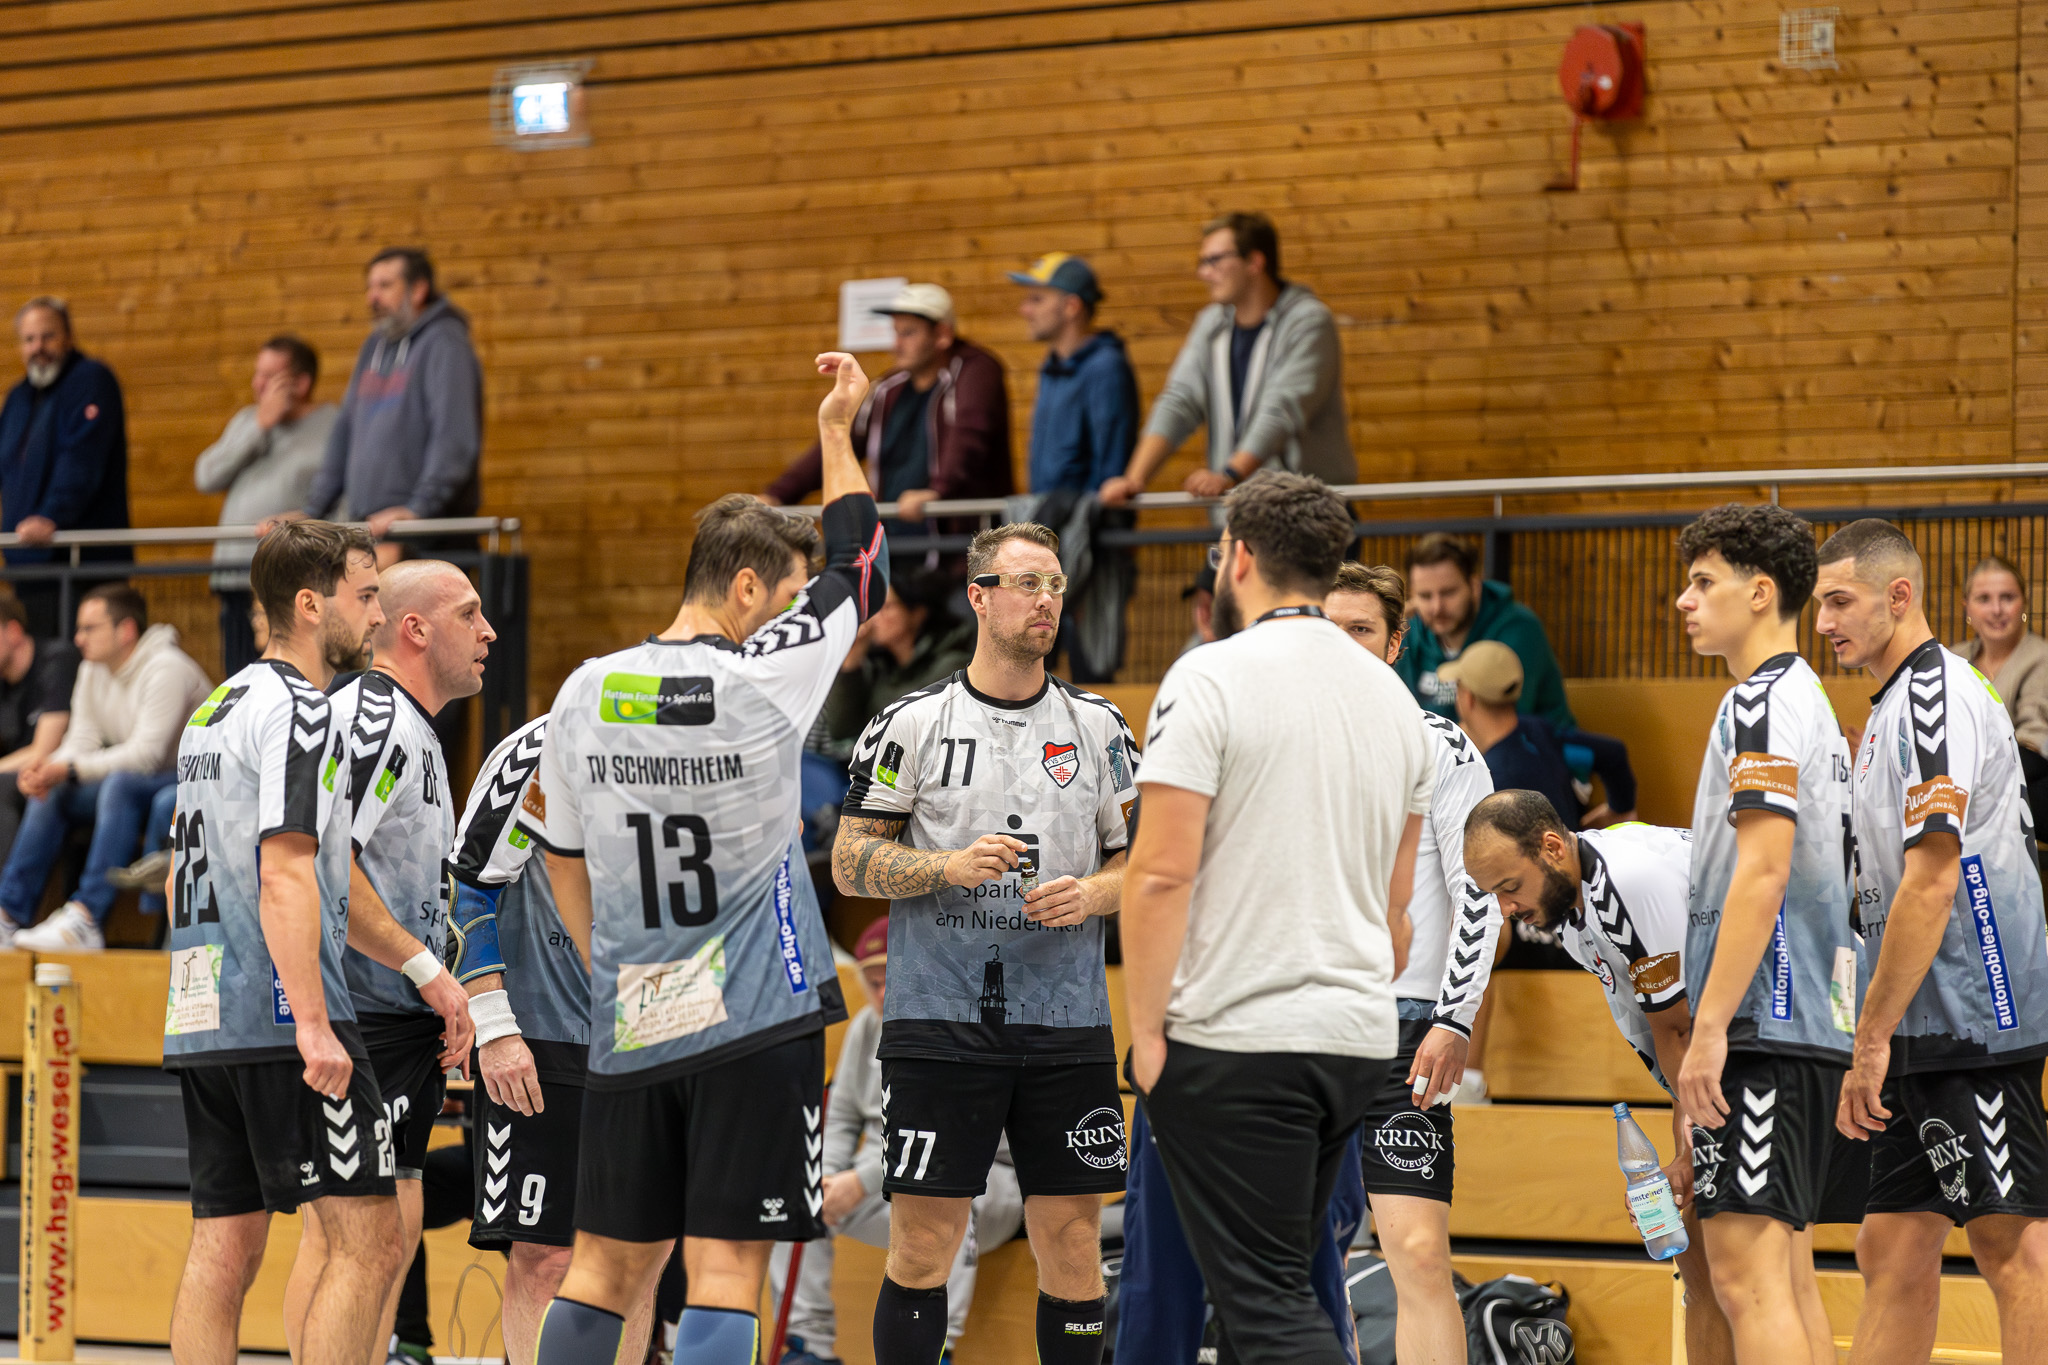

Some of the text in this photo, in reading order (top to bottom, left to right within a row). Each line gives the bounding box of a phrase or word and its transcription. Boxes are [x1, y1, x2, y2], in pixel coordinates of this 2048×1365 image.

[673, 693, 696, 705] Sport
[698, 692, 712, 703] AG
[1059, 752, 1074, 762] 1900
[586, 753, 744, 786] TV SCHWAFHEIM
[626, 813, 719, 929] 13
[936, 911, 964, 929] am
[1965, 863, 2013, 1027] automobiles-ohg.de
[1374, 1129, 1445, 1151] KRINK
[894, 1129, 936, 1180] 77
[1084, 1145, 1125, 1167] LIQUEURS
[1386, 1151, 1432, 1168] LIQUEURS
[45, 1004, 75, 1333] www.hsg-wesel.de
[519, 1173, 547, 1226] 9
[1065, 1321, 1103, 1331] SELECT
